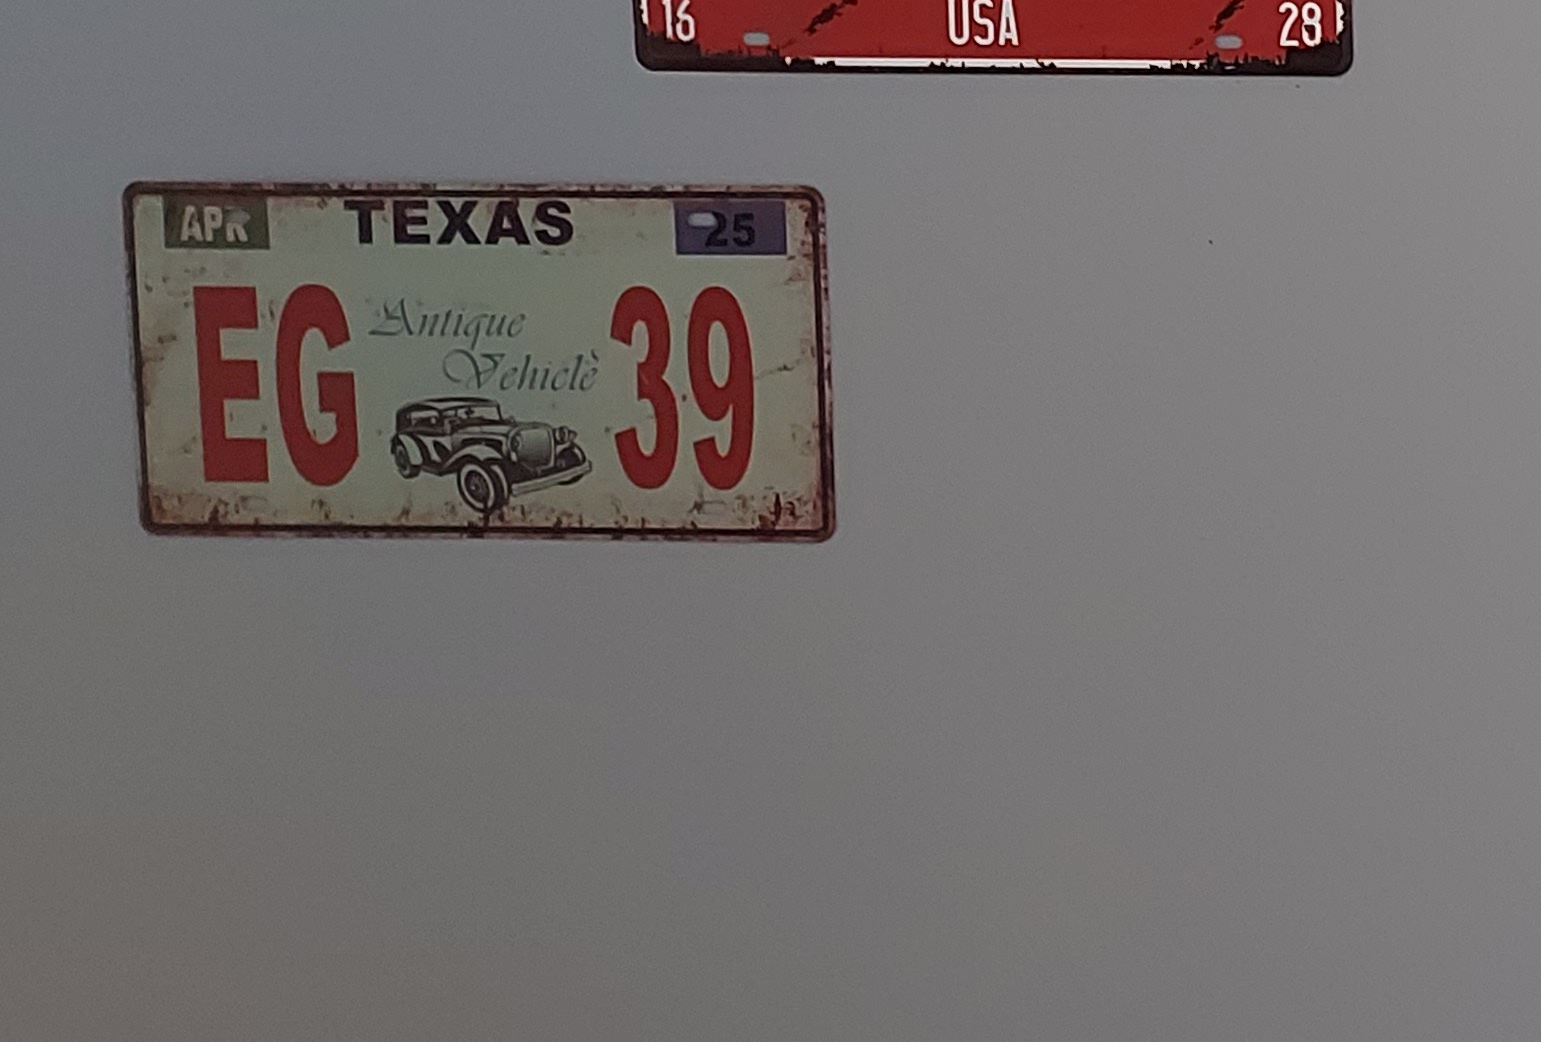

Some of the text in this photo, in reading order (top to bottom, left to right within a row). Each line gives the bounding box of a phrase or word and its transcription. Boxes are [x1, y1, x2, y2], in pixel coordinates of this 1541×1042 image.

[1278, 1, 1322, 47] 28
[345, 199, 575, 247] TEXAS
[704, 211, 756, 247] 25
[368, 298, 526, 351] Antique
[193, 284, 755, 490] EG 39
[442, 349, 599, 392] Vehicle
